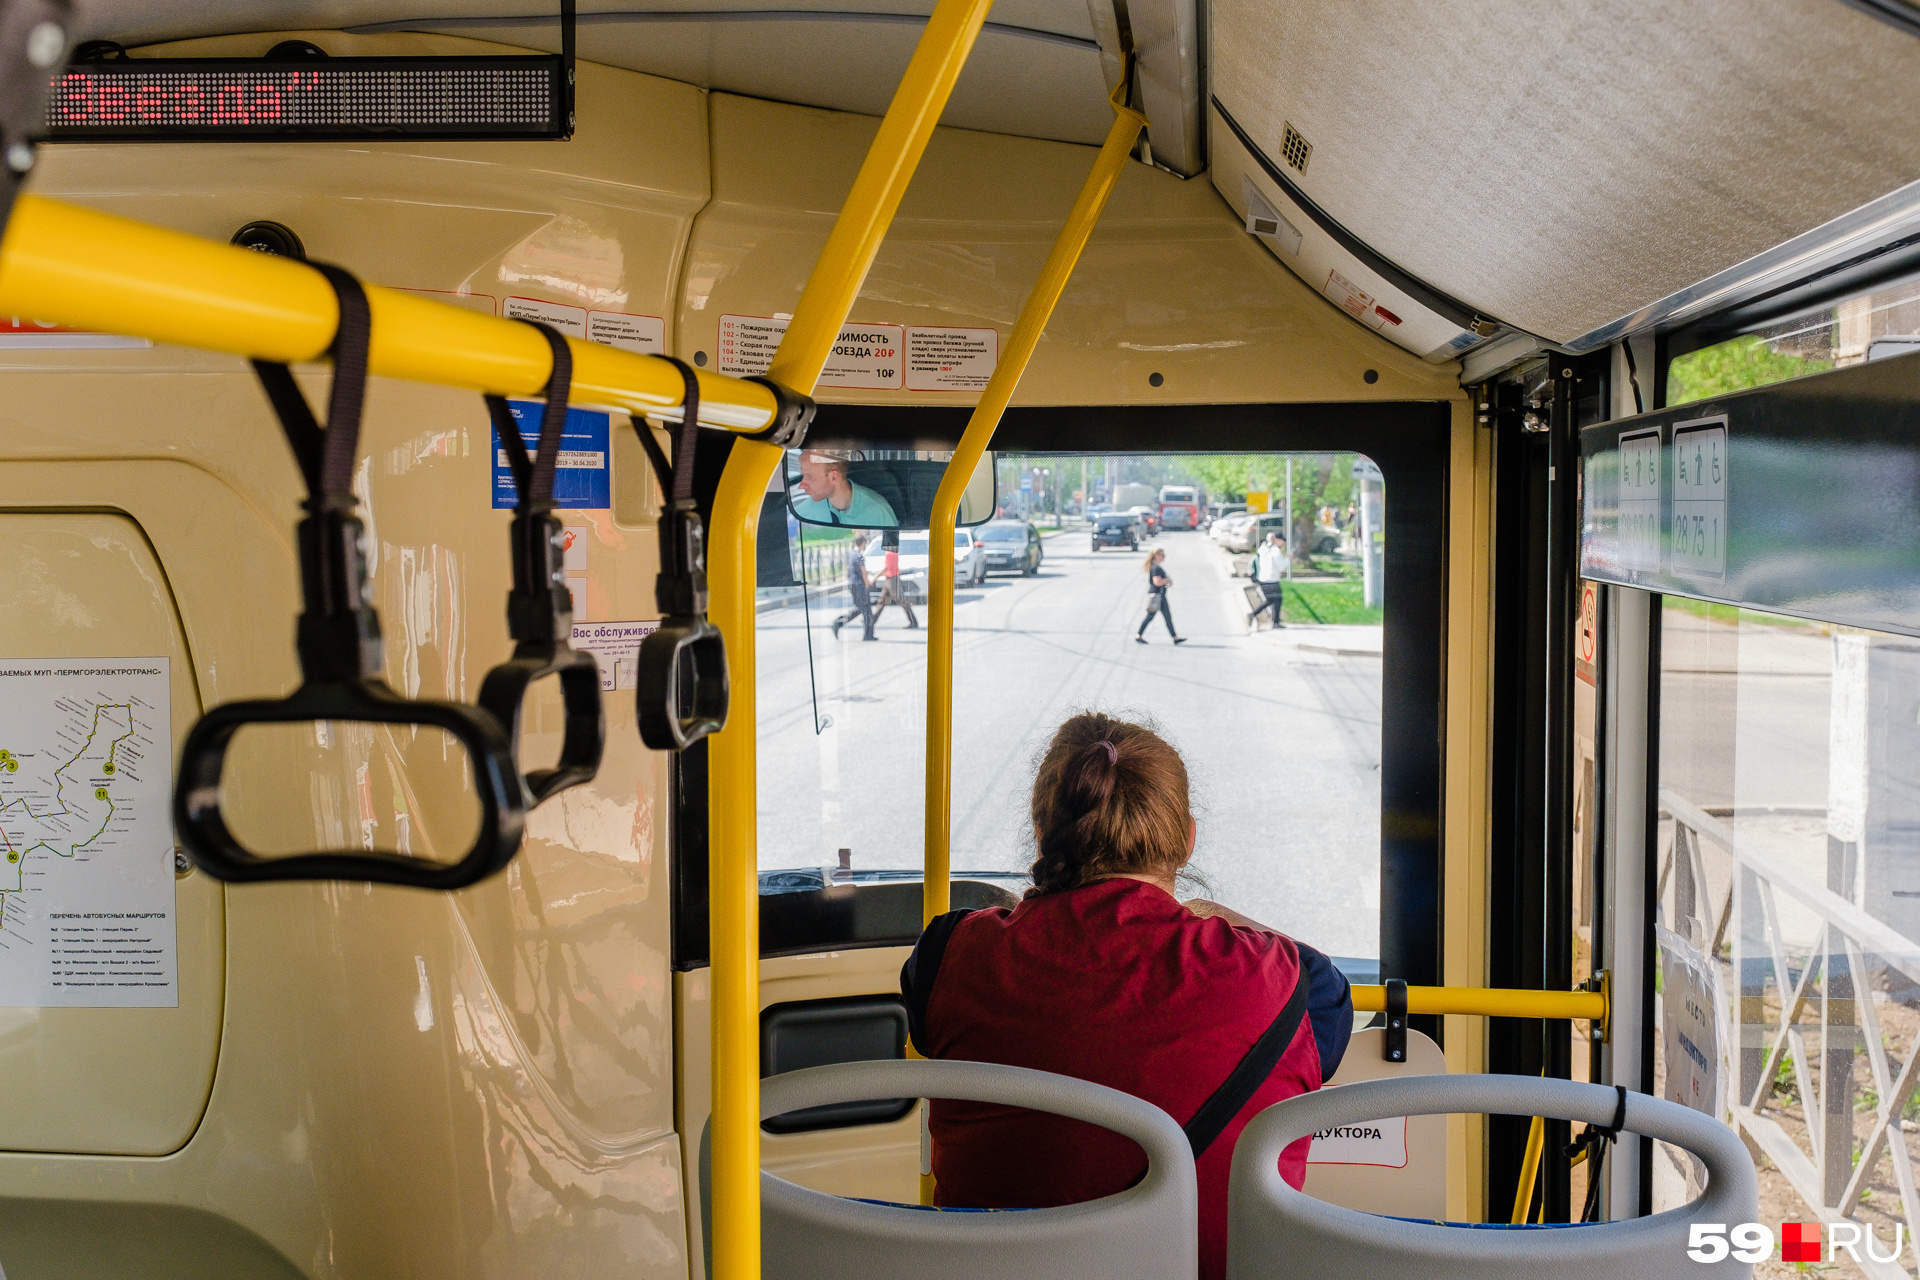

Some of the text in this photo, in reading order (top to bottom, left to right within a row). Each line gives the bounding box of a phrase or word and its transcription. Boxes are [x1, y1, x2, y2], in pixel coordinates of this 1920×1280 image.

[523, 313, 581, 326] «ПермГорЭлектроТранс»
[741, 324, 773, 333] Пожарная
[618, 334, 653, 342] администрации
[740, 333, 769, 341] Полиция
[740, 341, 763, 349] Скорая
[1675, 515, 1688, 555] 28
[1692, 516, 1705, 557] 75
[573, 628, 591, 638] Вас
